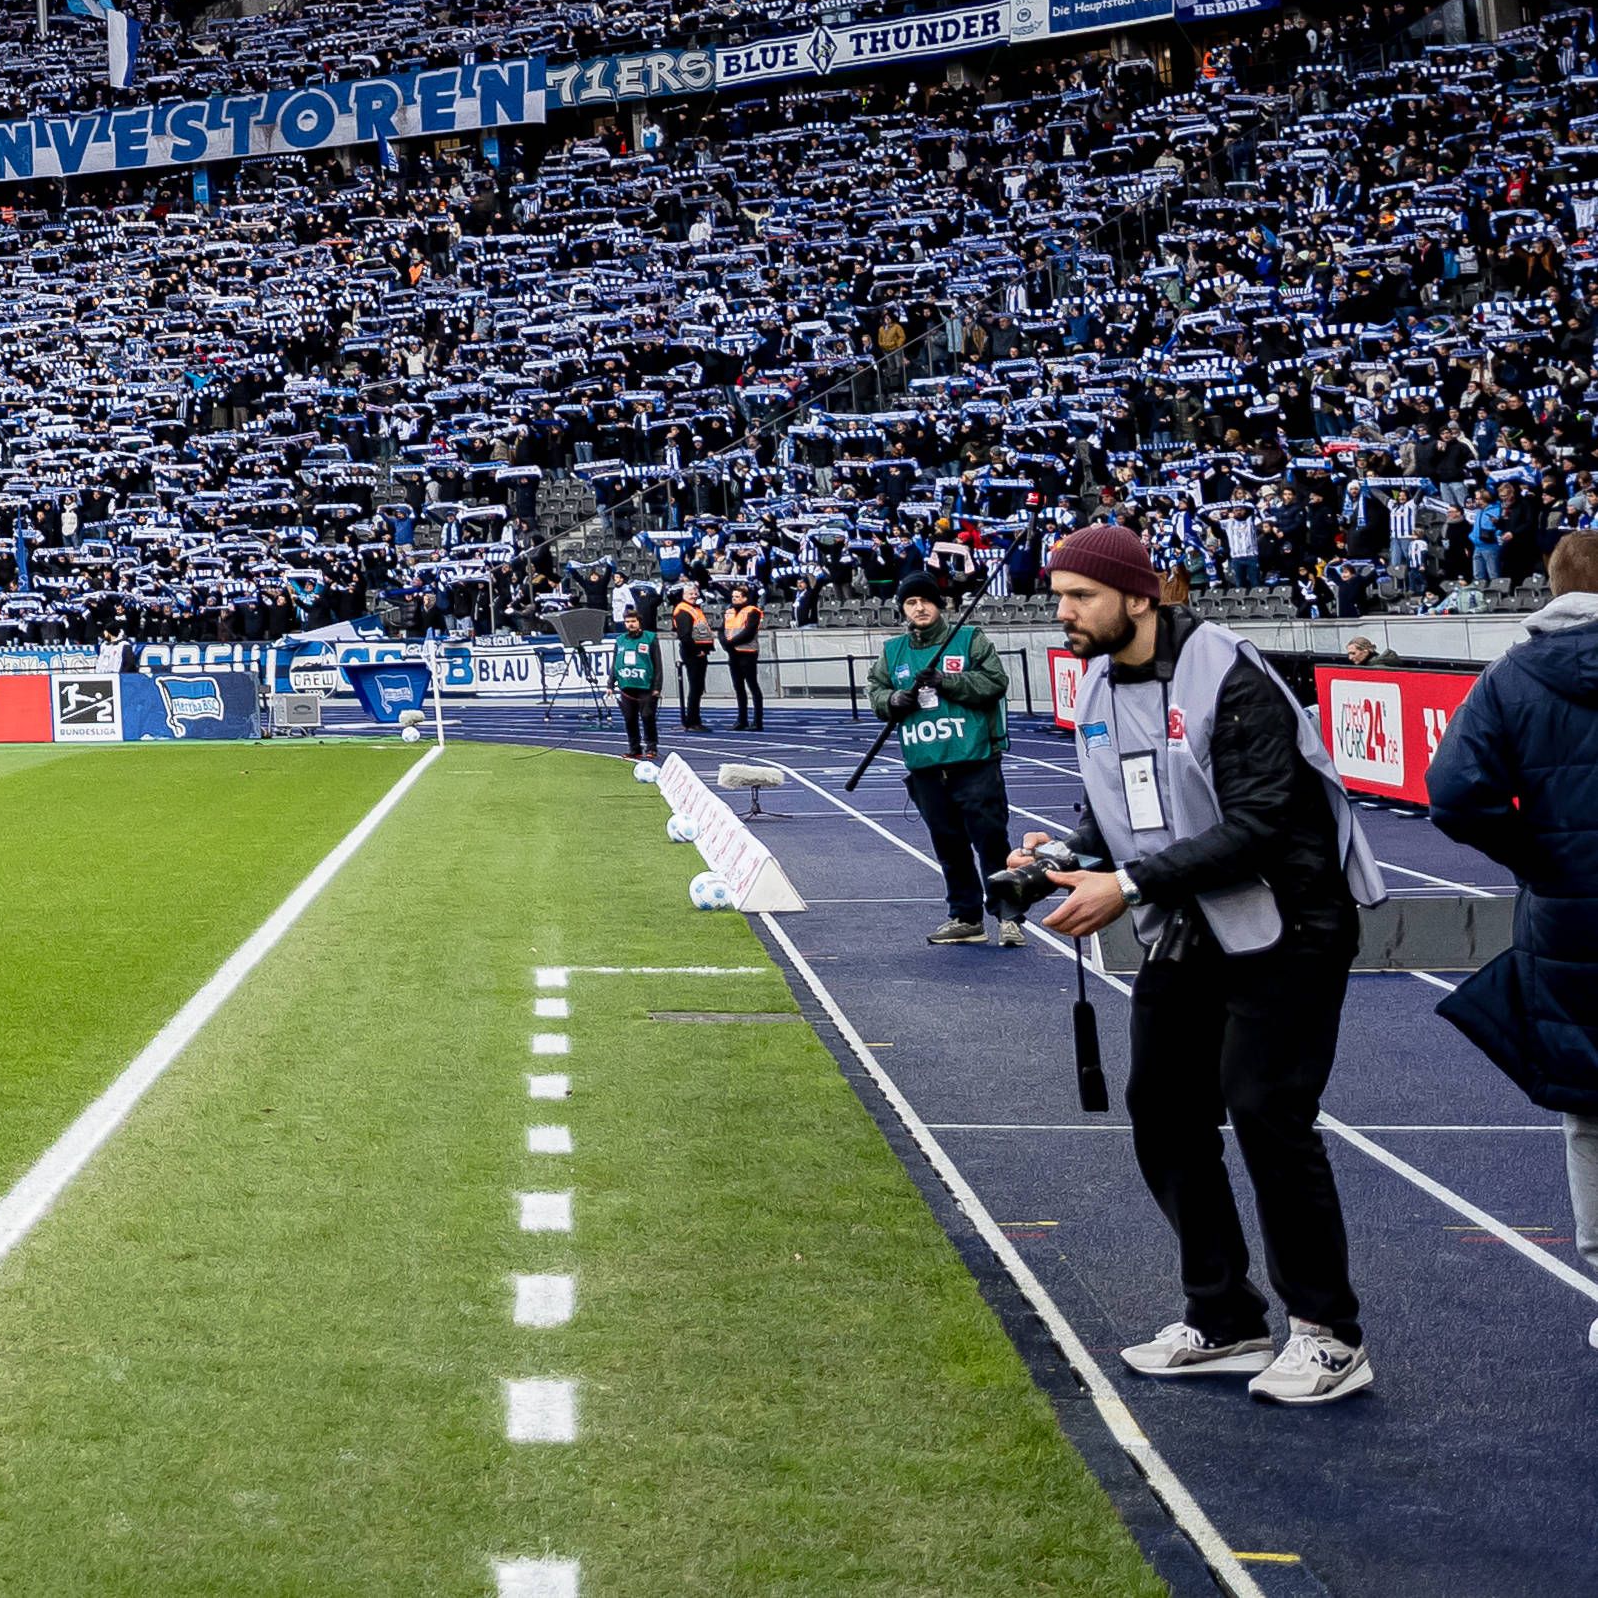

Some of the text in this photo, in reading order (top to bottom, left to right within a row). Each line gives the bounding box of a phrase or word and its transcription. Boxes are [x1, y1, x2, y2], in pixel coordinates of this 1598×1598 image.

[1052, 5, 1071, 17] Die
[722, 44, 799, 77] BLUE
[849, 10, 1002, 56] THUNDER
[546, 51, 713, 105] 71ERS
[293, 673, 334, 687] CREW
[478, 658, 529, 682] BLAU
[60, 728, 116, 736] BUNDESLIGA
[902, 718, 966, 746] HOST
[1363, 698, 1386, 763] 24
